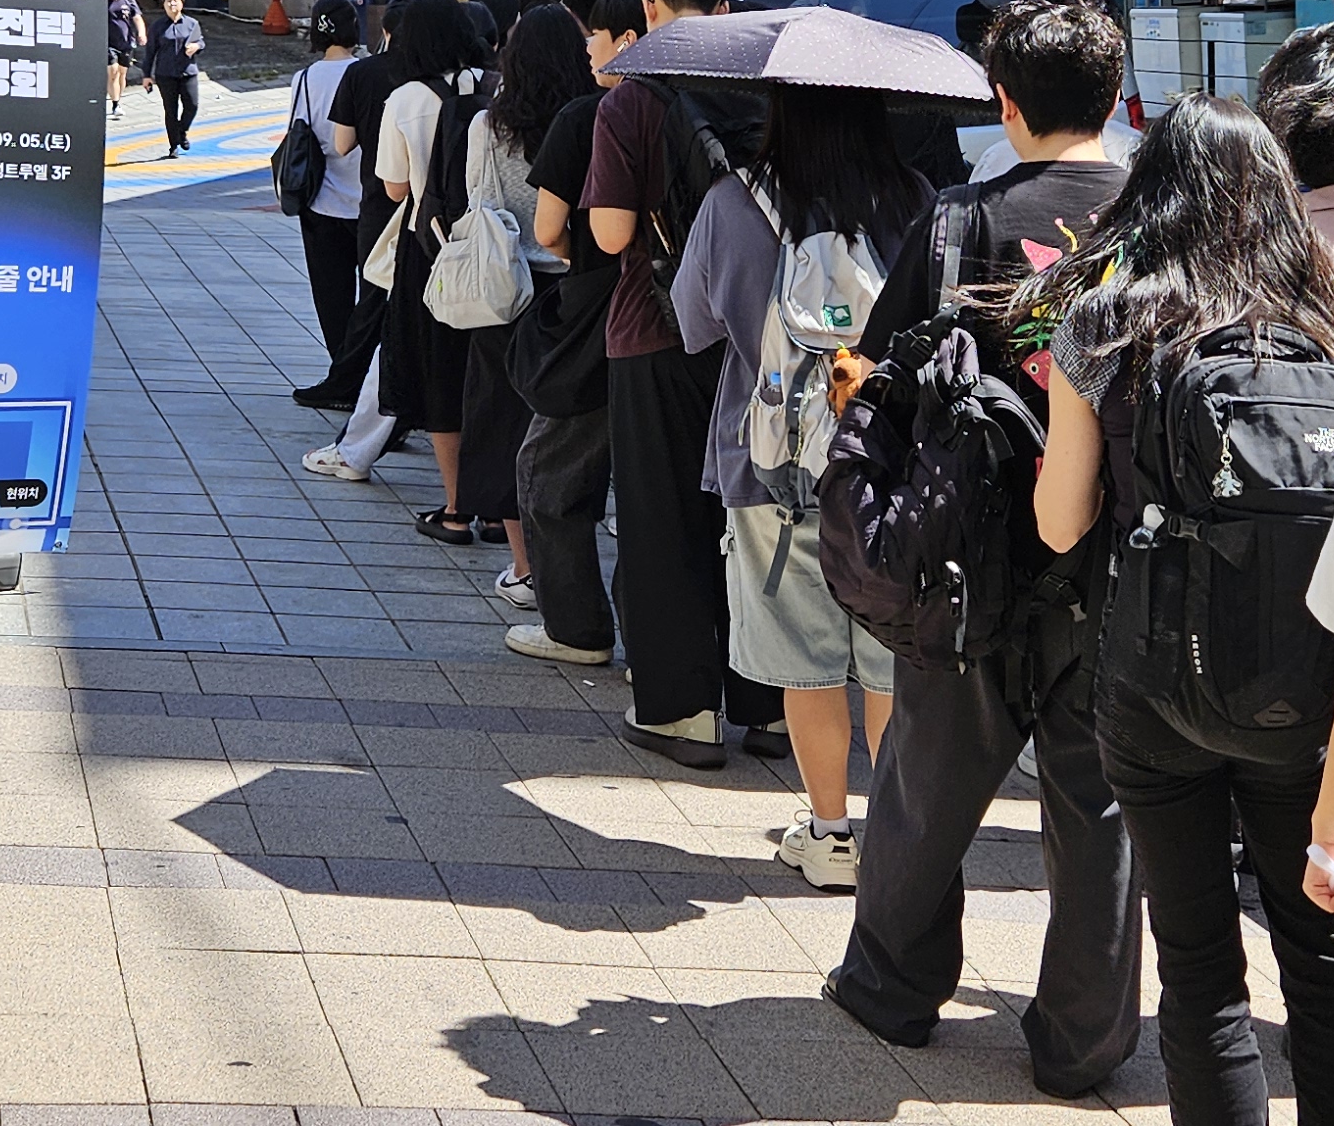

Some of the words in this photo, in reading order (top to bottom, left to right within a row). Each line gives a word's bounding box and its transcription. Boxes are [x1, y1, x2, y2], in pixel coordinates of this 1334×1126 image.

[51, 165, 72, 180] 3F
[26, 265, 74, 293] 안내
[6, 486, 40, 501] 현위치
